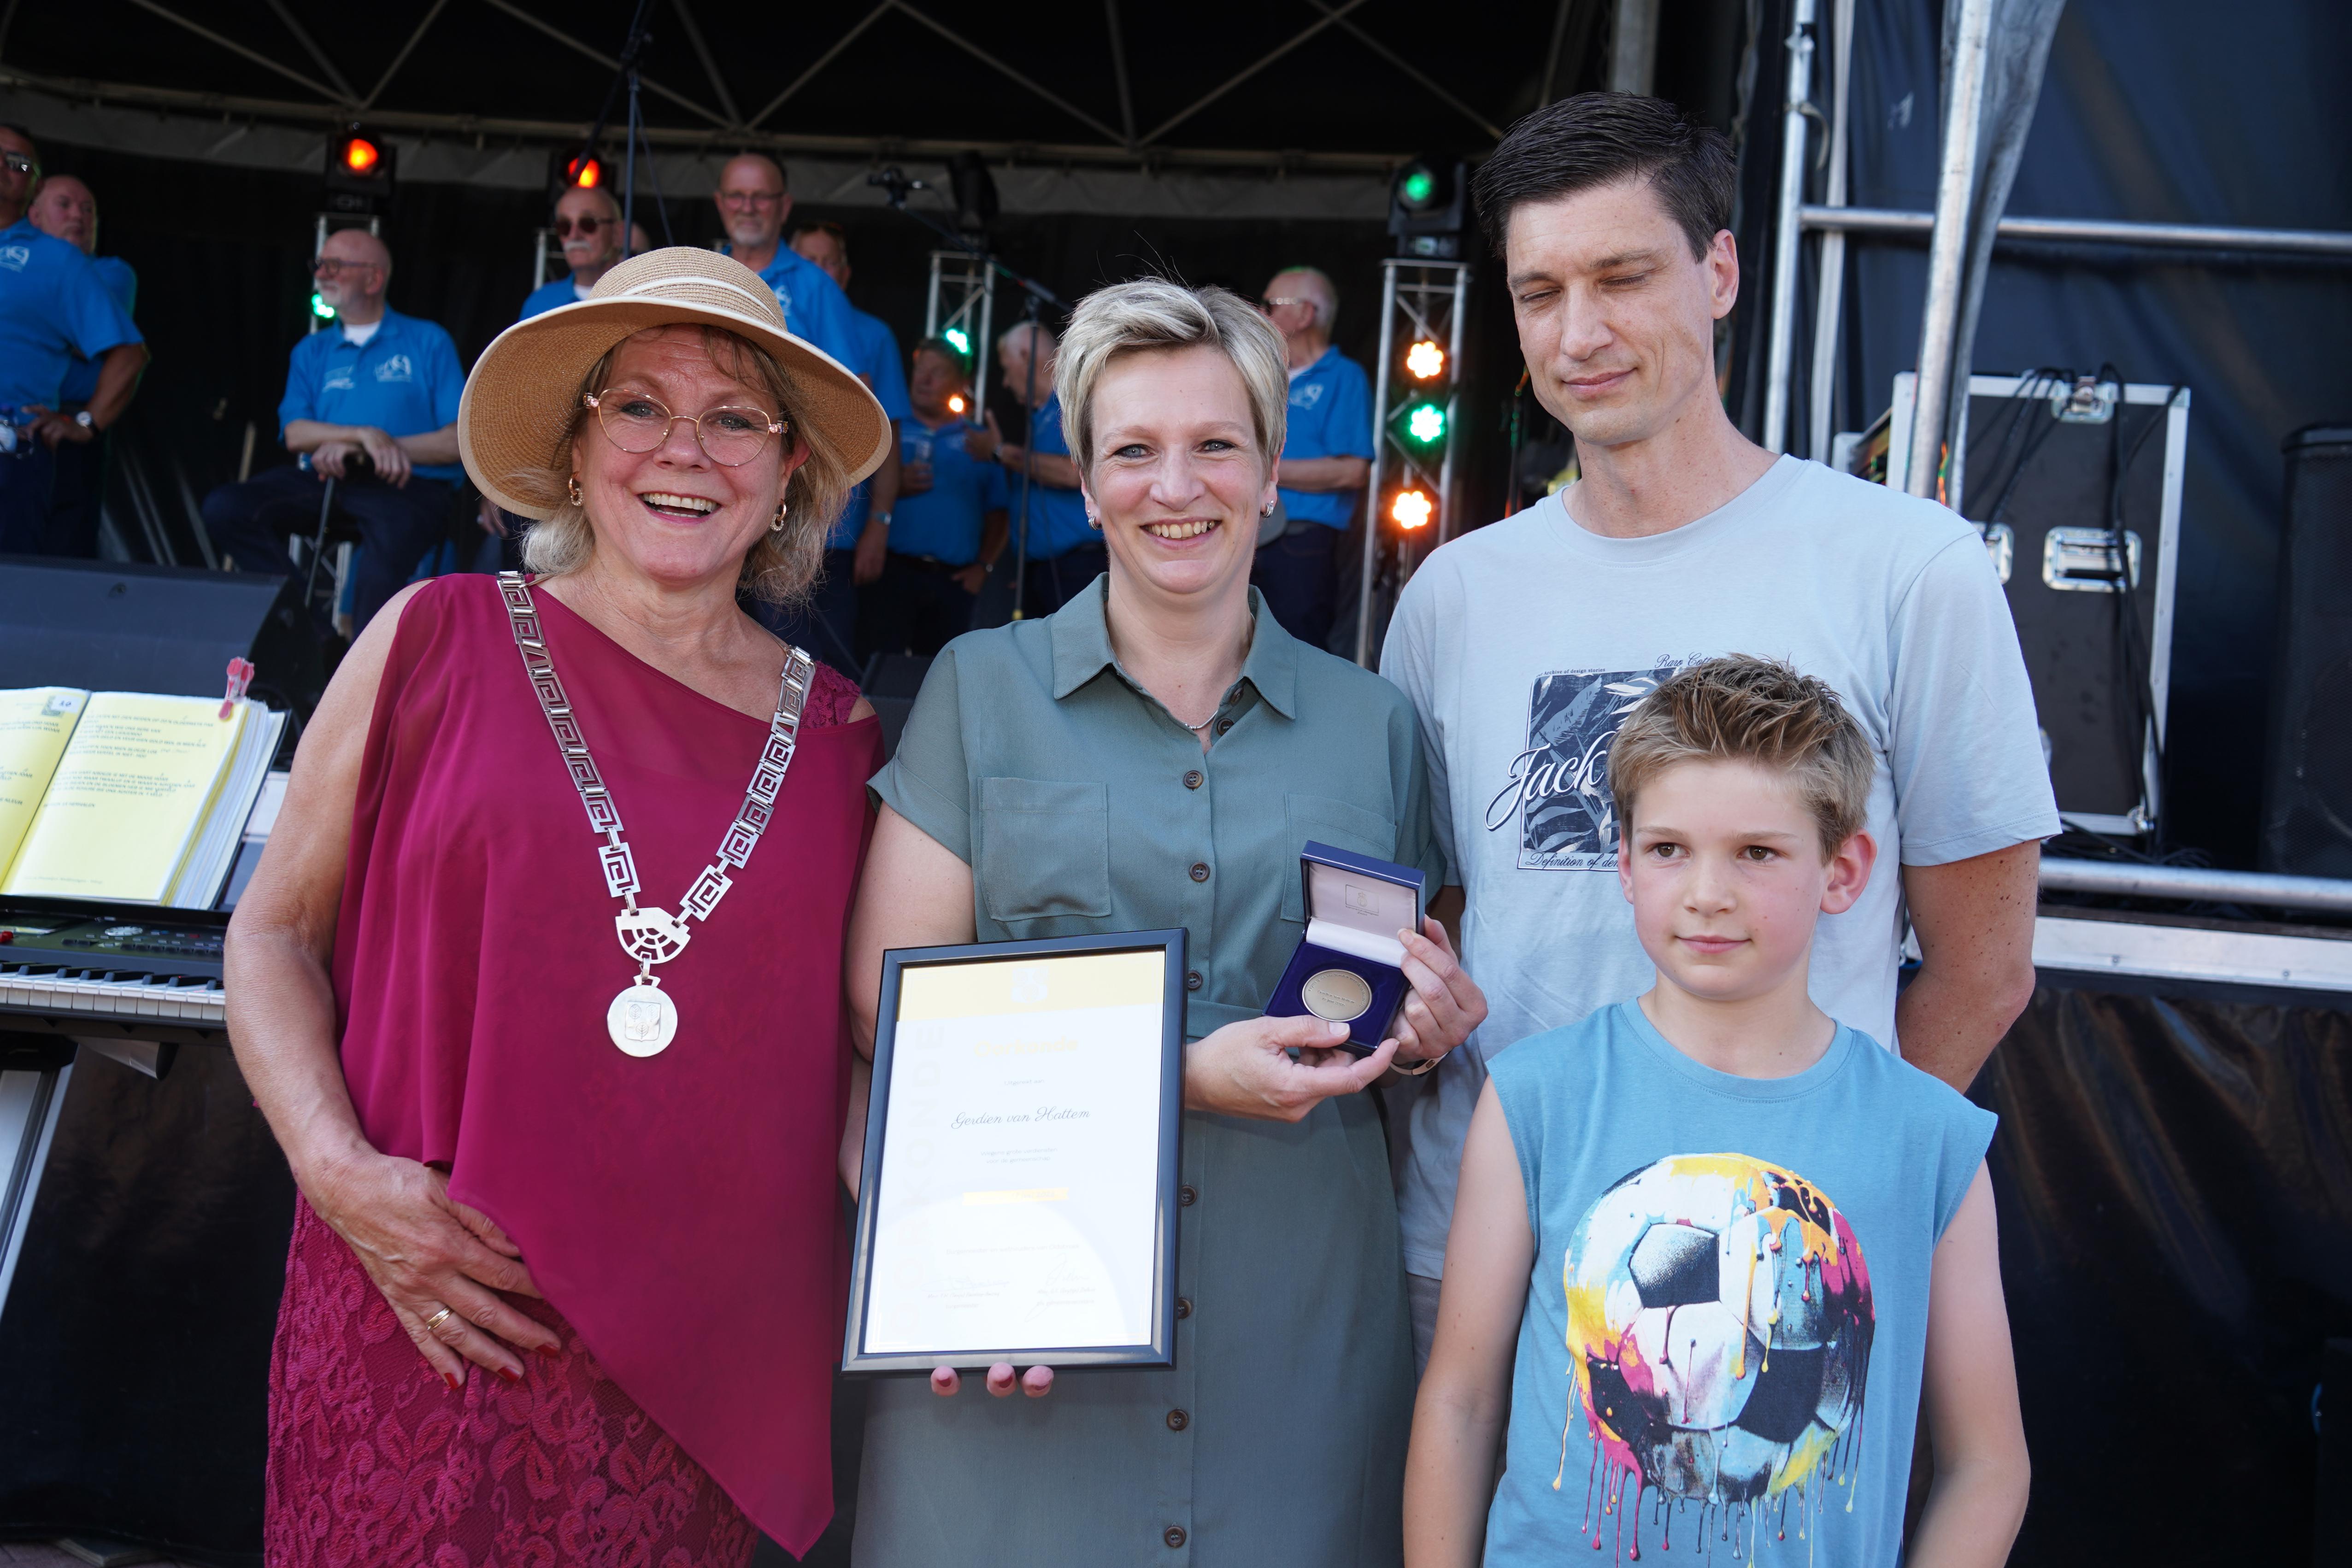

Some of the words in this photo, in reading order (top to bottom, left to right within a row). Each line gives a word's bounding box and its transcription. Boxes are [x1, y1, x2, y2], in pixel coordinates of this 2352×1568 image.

[1655, 654, 1683, 668] Raw
[1485, 731, 1616, 832] Jack
[1525, 852, 1584, 870] Definition
[1587, 853, 1604, 870] of
[951, 1112, 1003, 1129] Gerdien
[1007, 1113, 1031, 1123] van
[1035, 1106, 1090, 1122] Hattem
